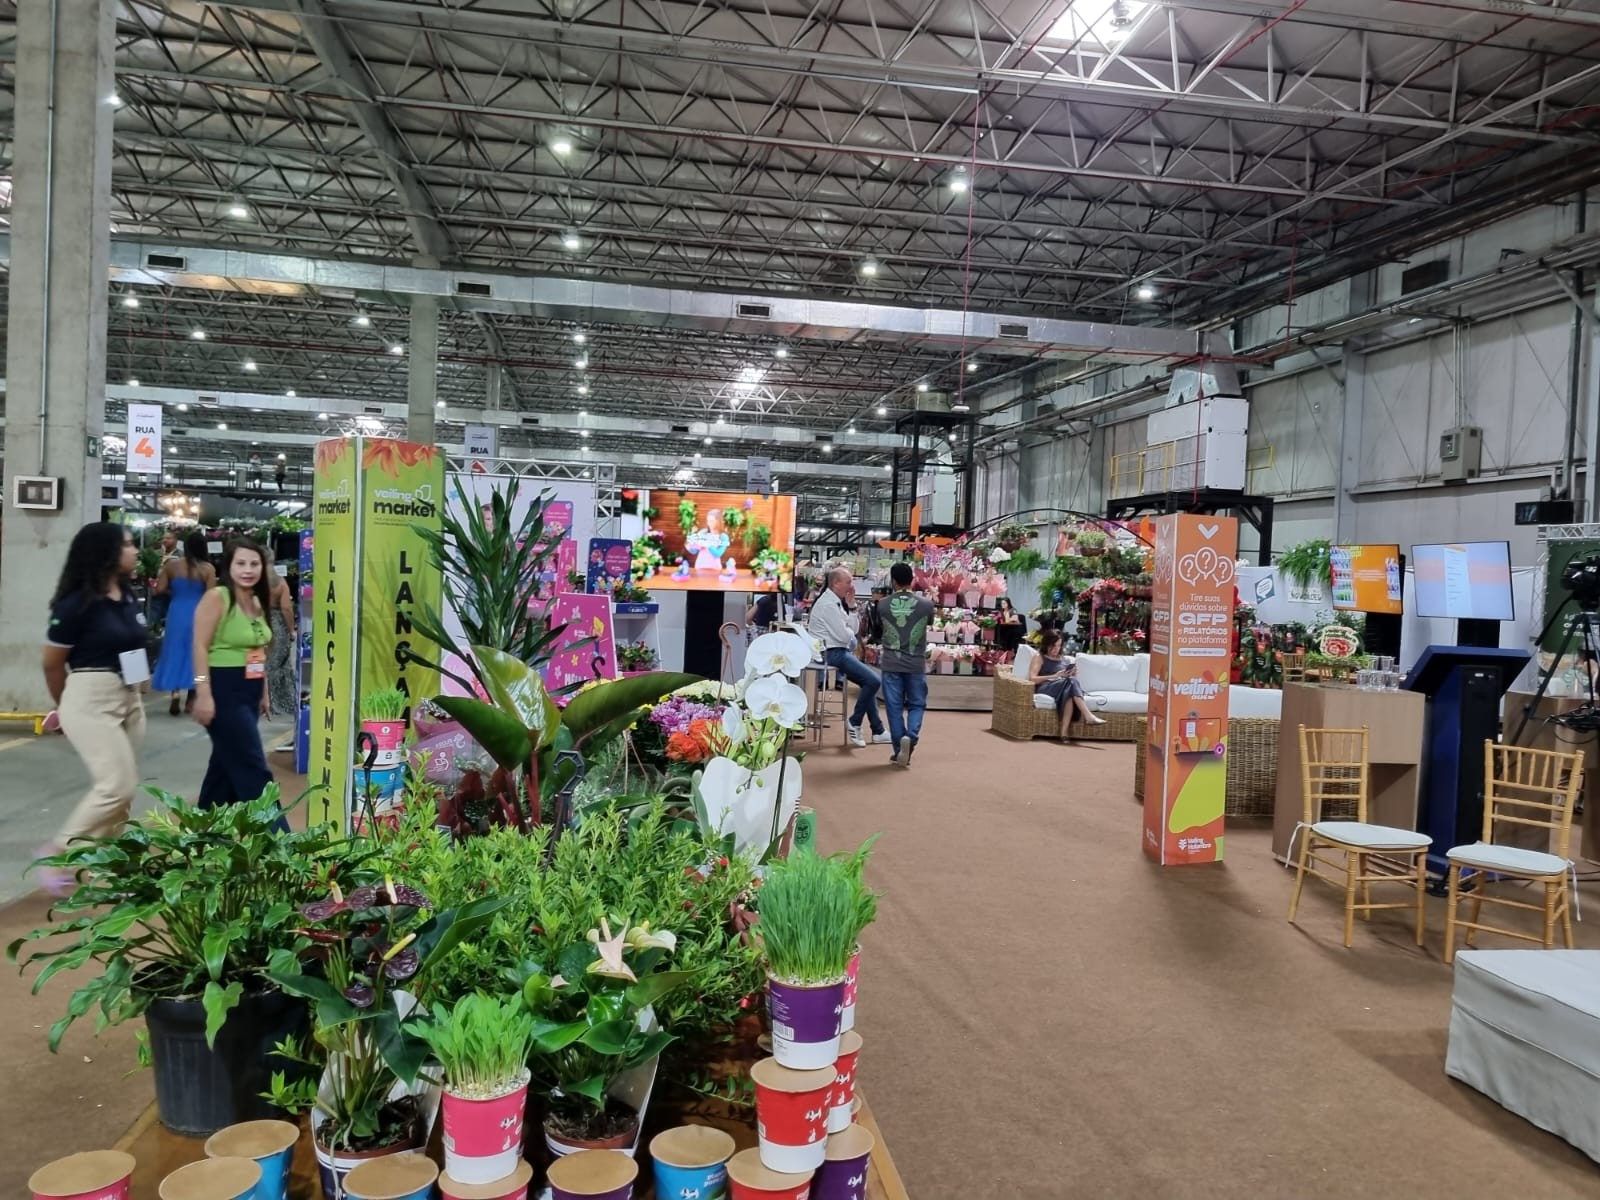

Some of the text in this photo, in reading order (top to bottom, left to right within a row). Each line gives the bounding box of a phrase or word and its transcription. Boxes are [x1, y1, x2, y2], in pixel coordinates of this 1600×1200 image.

[135, 426, 155, 434] RUA
[135, 437, 154, 458] 4
[470, 446, 488, 454] RUA
[319, 498, 350, 515] market
[374, 501, 436, 518] market
[1191, 593, 1204, 602] Tire
[1179, 601, 1207, 611] dúvidas
[1208, 603, 1228, 612] sobre
[1179, 612, 1228, 625] GFP
[1183, 626, 1228, 635] RELATÓRIOS
[1188, 636, 1228, 645] plataforma
